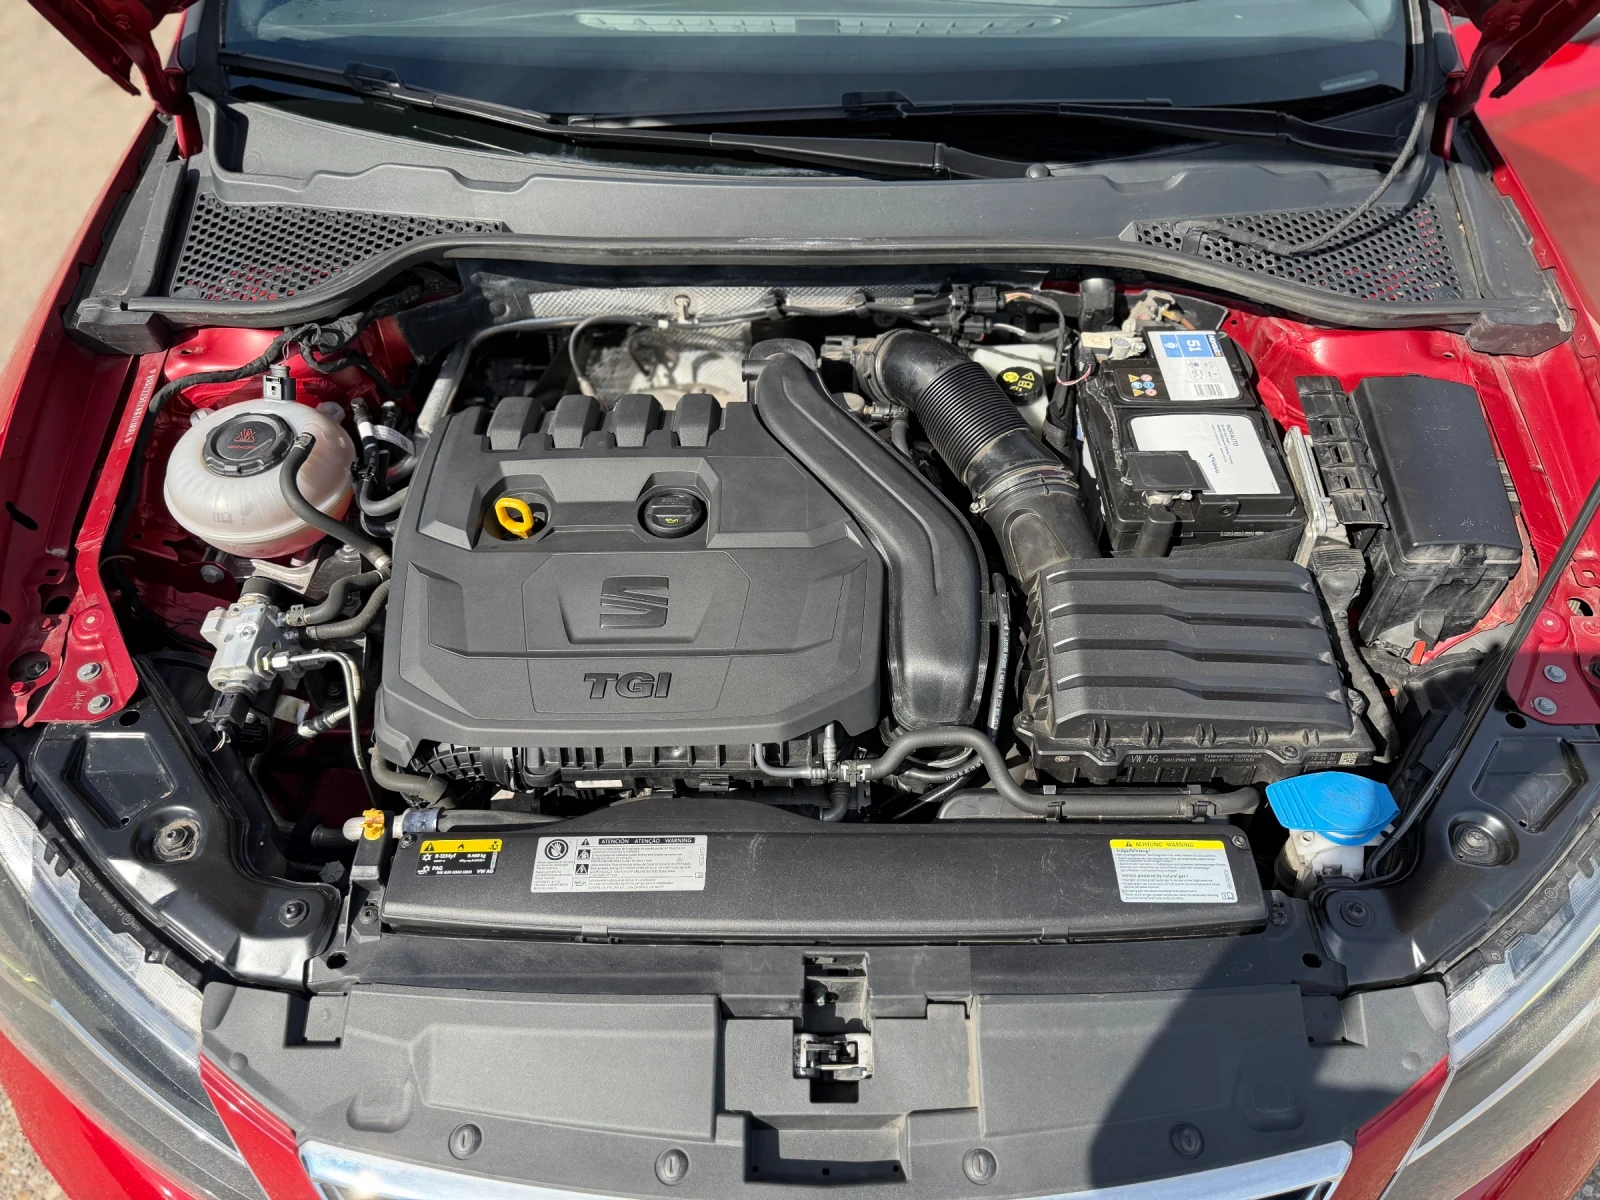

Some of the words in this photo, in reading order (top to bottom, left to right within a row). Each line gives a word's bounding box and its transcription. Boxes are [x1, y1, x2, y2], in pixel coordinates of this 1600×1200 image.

[1186, 339, 1203, 352] 51
[1226, 424, 1239, 447] NORAUTO
[583, 671, 672, 700] TGI
[1131, 754, 1143, 762] VW
[1146, 754, 1159, 763] AG
[634, 837, 661, 845] ATENÇÃO
